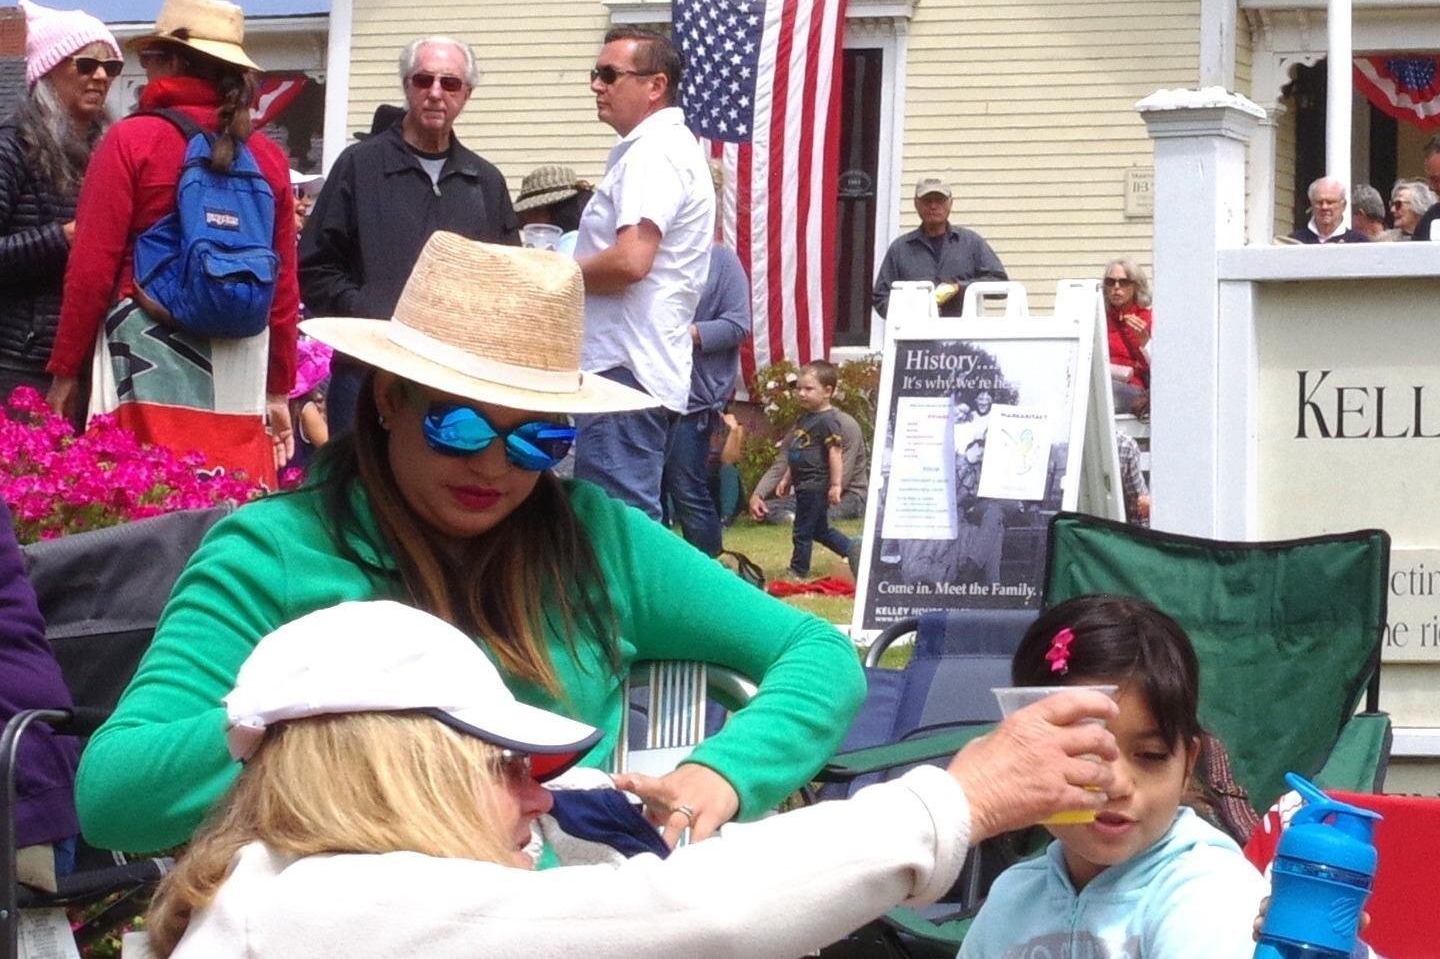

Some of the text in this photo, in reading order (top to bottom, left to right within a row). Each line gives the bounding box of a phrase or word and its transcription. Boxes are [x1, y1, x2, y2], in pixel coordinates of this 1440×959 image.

[903, 376, 922, 390] It's
[956, 376, 991, 390] we're
[878, 581, 1037, 600] Come in. Meet the Family.
[875, 606, 910, 615] KELLEY
